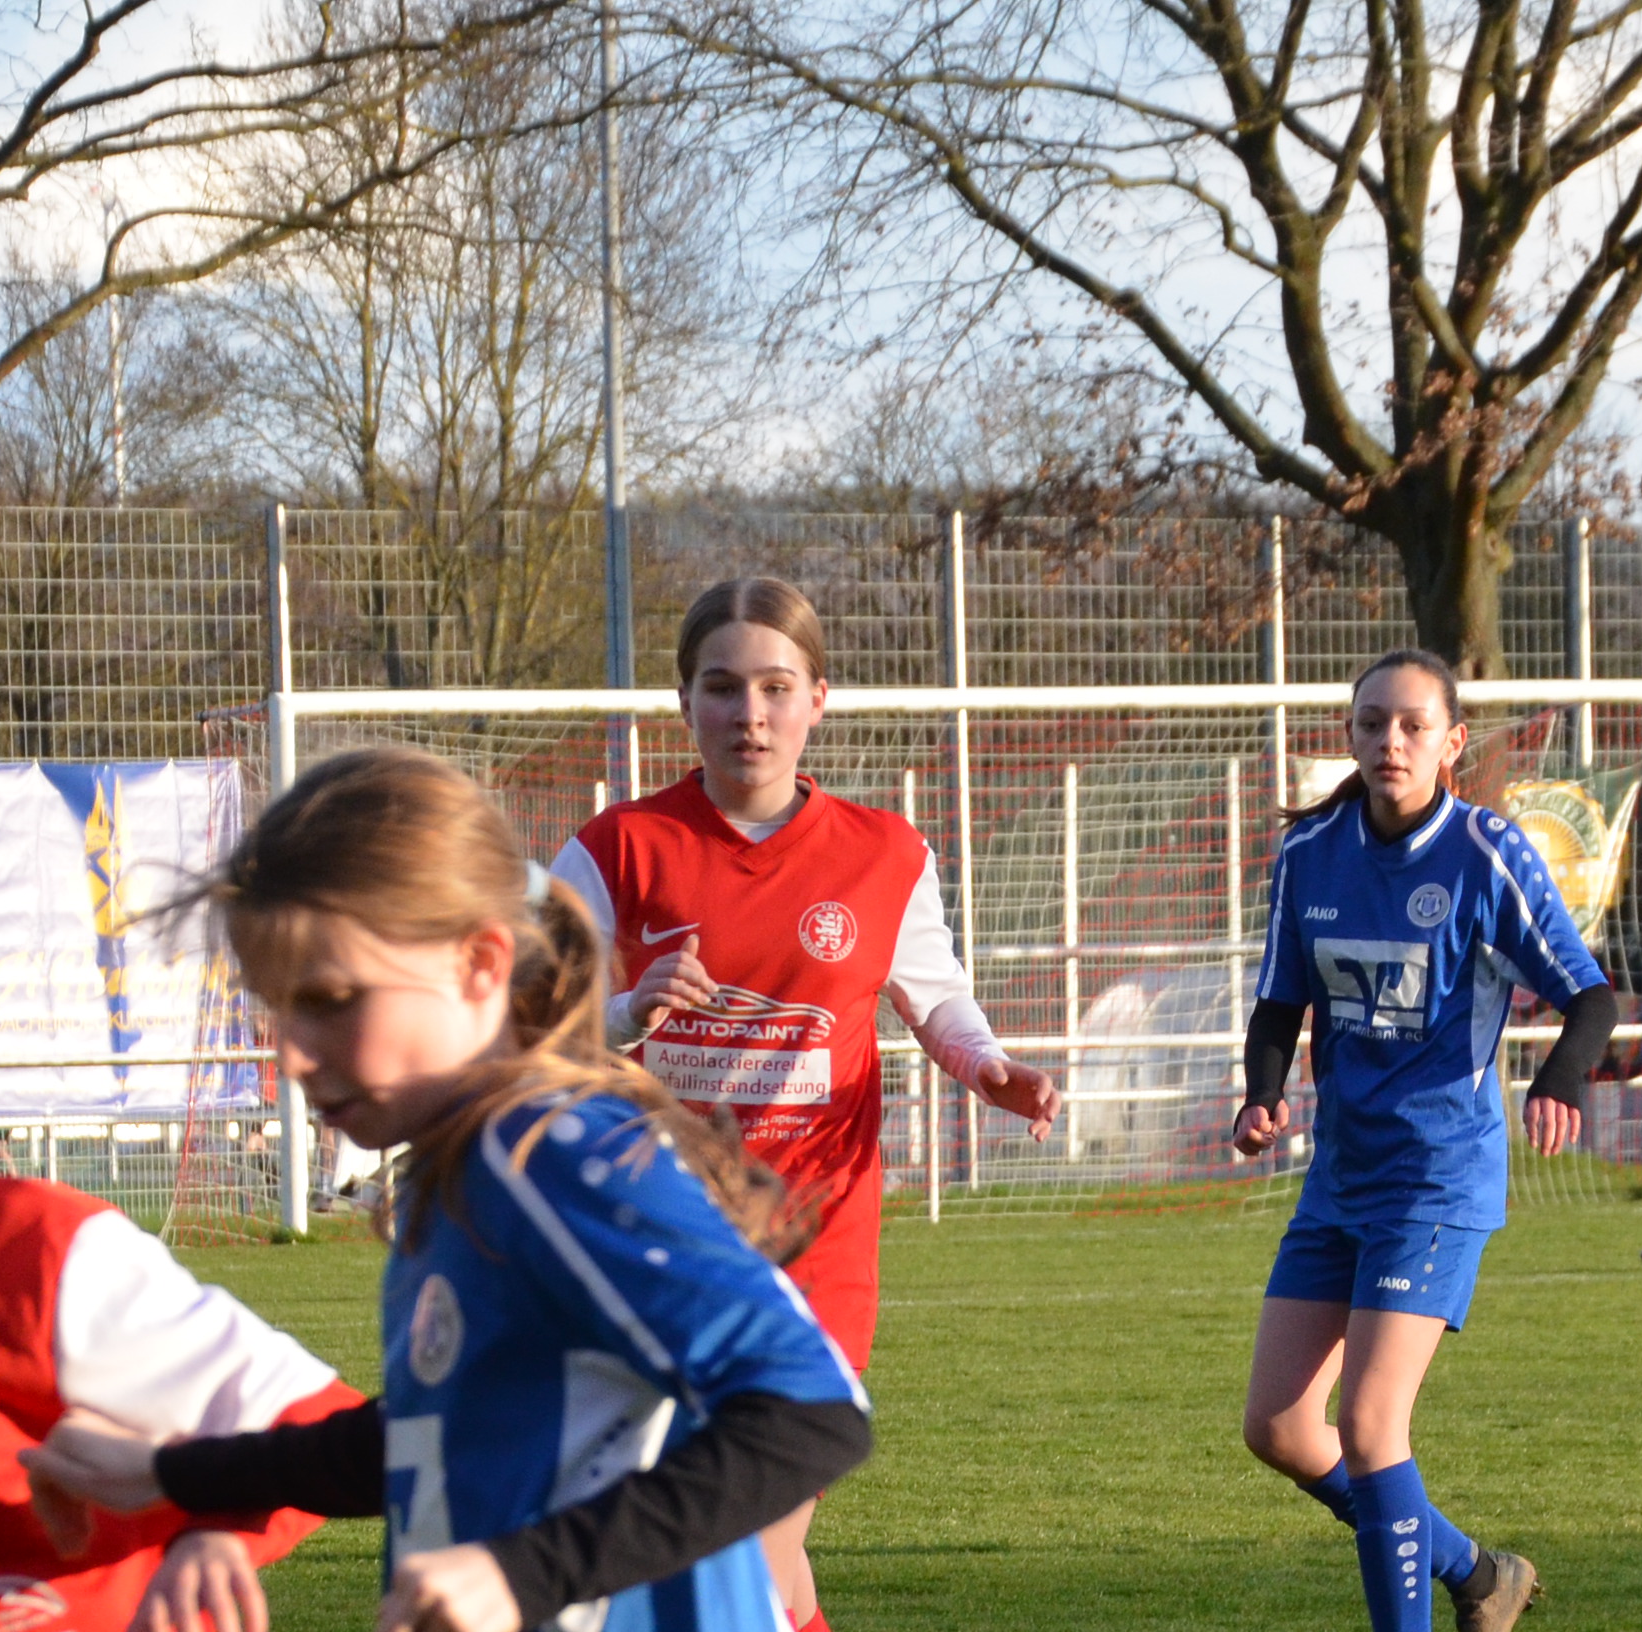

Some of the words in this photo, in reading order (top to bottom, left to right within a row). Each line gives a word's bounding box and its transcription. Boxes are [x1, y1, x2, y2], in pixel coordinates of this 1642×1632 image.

[1304, 906, 1339, 920] JAKO
[661, 1018, 804, 1041] AUTOPAINT
[658, 1049, 796, 1072] Autolackiererei
[651, 1070, 827, 1099] nfallinstandsetzung
[1376, 1275, 1411, 1291] JAKO
